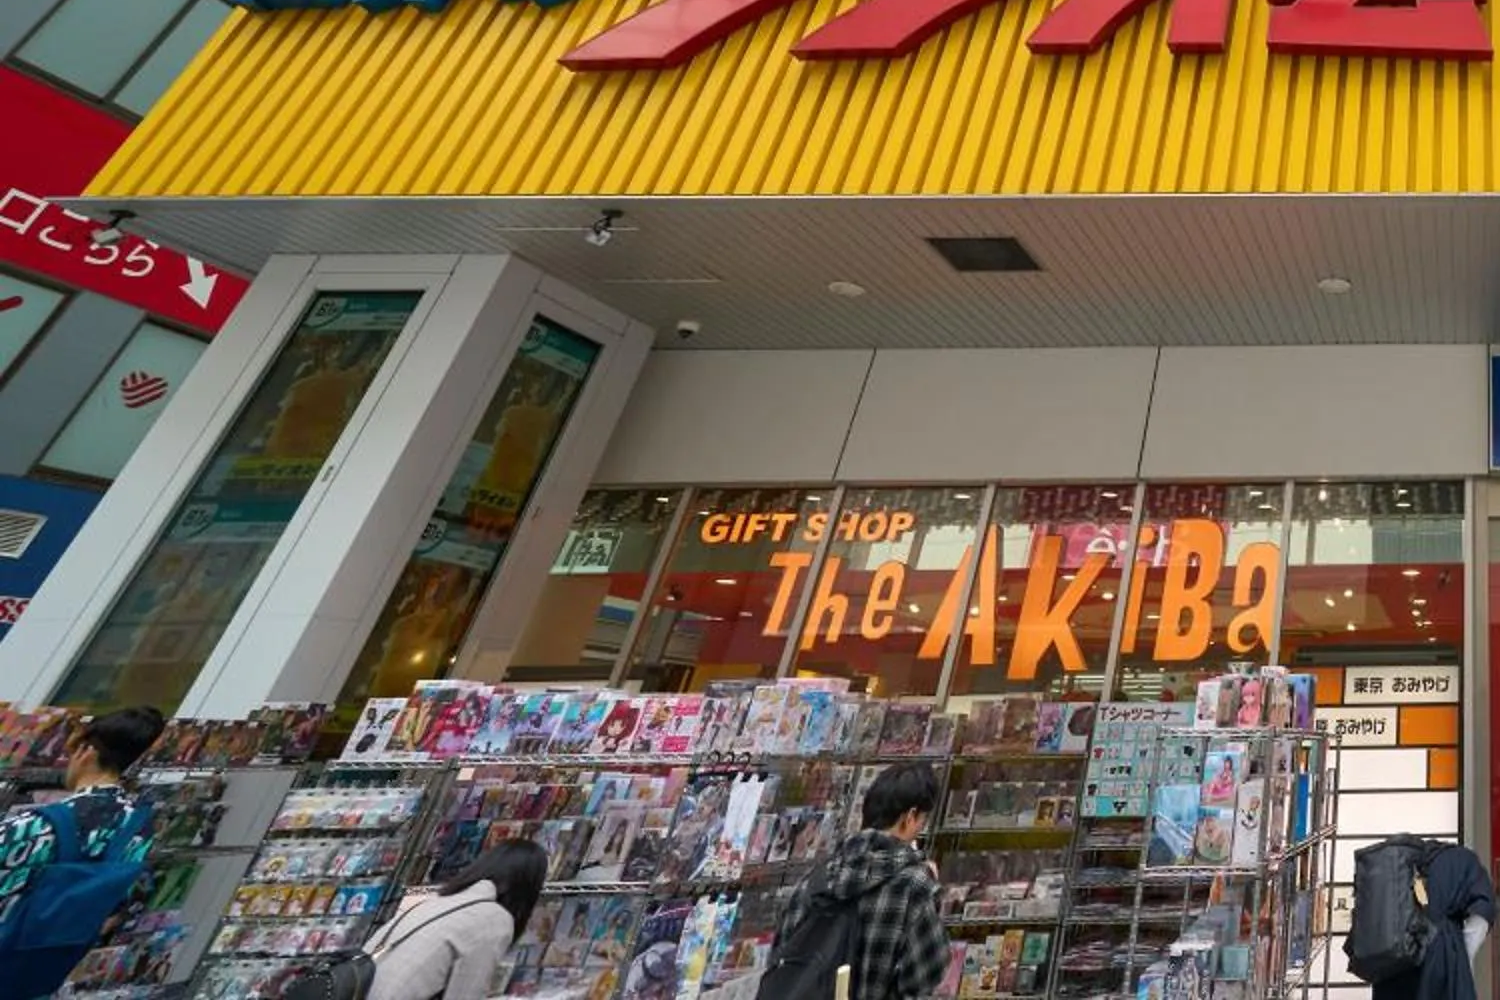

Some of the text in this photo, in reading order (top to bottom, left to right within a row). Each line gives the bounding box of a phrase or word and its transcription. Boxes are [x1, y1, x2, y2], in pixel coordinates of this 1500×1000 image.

[701, 513, 914, 543] GIFT SHOP
[763, 551, 905, 650] The
[1353, 676, 1451, 693] 東京 おみやげ
[1100, 704, 1181, 724] Tシャツコーナー
[1335, 717, 1386, 734] おみやげ
